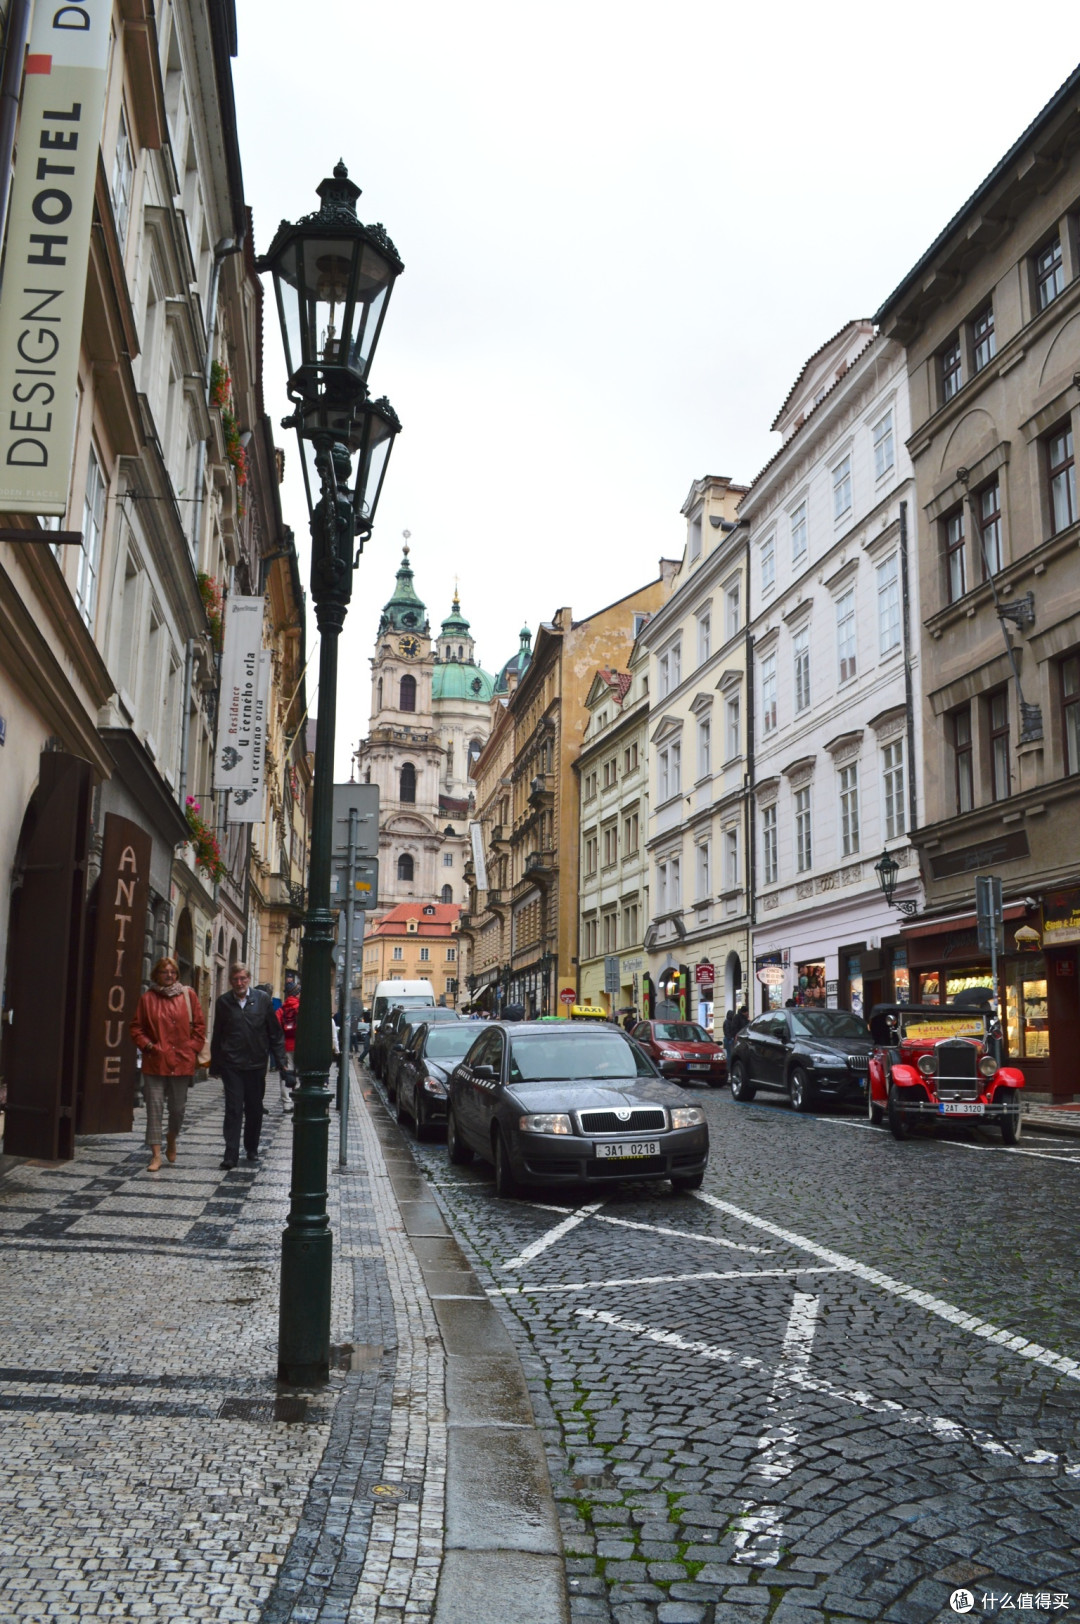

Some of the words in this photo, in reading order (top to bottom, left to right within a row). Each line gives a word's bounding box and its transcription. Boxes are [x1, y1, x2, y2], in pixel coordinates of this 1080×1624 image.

[53, 0, 90, 31] D
[27, 103, 81, 265] HOTEL
[6, 288, 64, 467] DESIGN
[244, 652, 256, 677] orla
[228, 686, 240, 734] Residence
[240, 682, 253, 732] černého
[238, 739, 250, 747] U
[103, 846, 137, 1084] ANTIQUE
[945, 1104, 958, 1112] 2AT
[963, 1105, 982, 1113] 3120
[604, 1145, 623, 1156] 3A1
[631, 1143, 656, 1155] 0218
